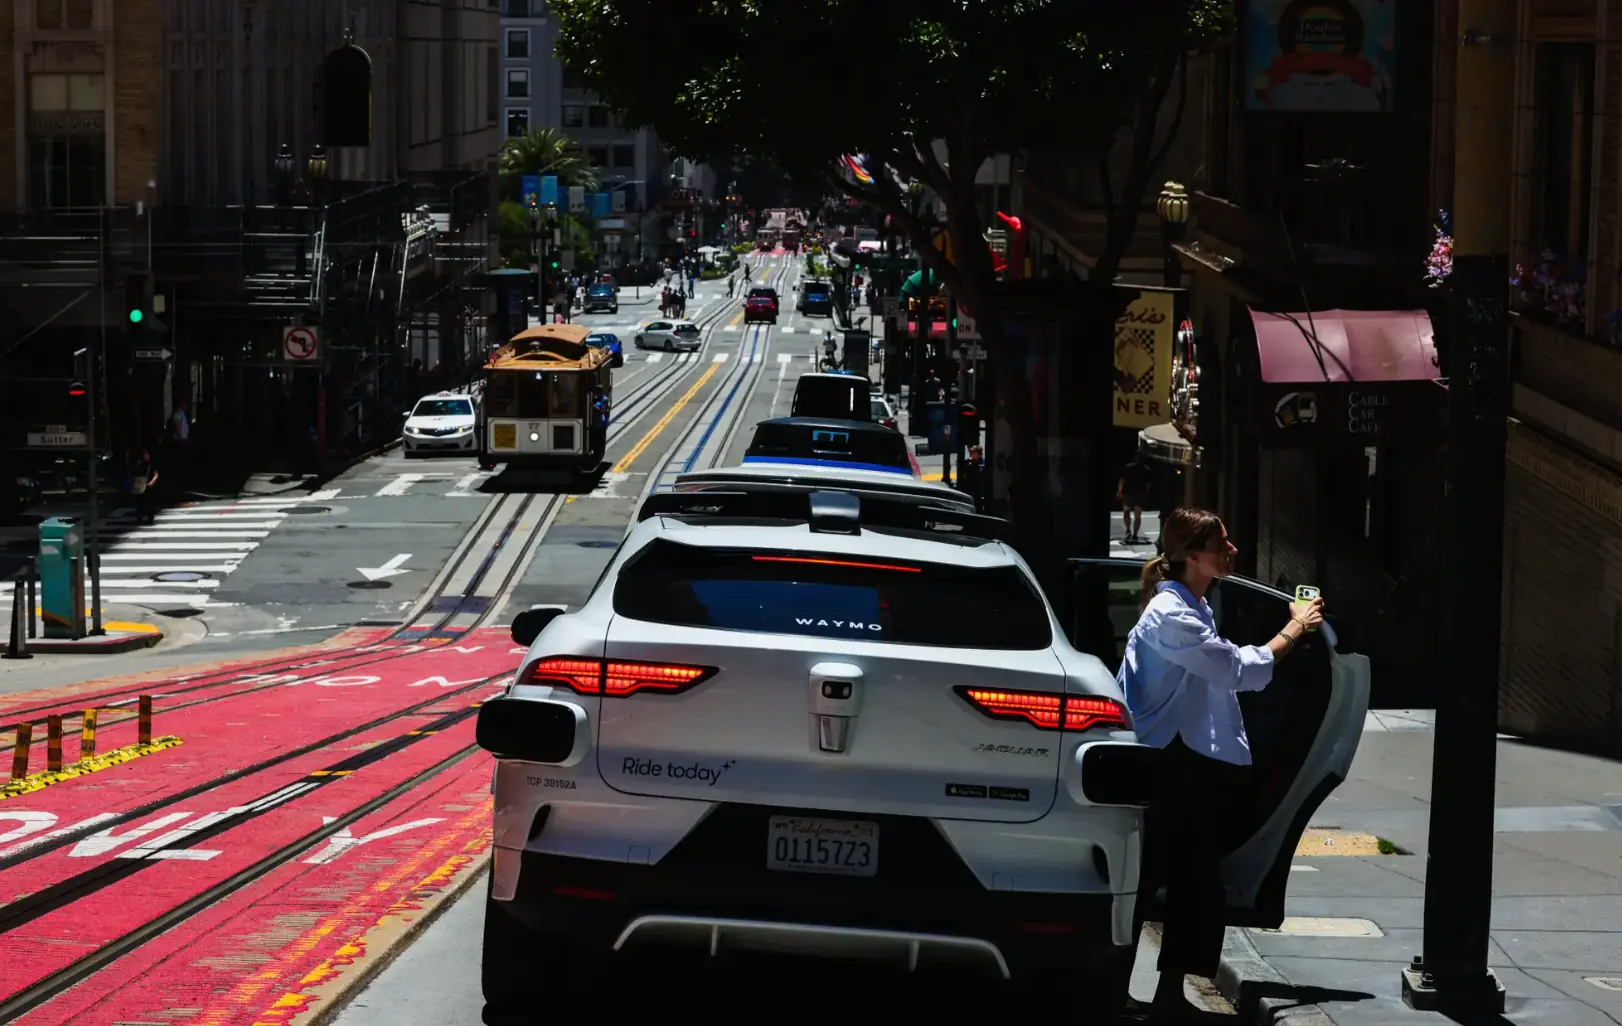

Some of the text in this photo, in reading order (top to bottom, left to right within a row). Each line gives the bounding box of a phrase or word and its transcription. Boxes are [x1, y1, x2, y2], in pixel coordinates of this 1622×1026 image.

[1348, 391, 1389, 406] CABLE
[1116, 397, 1161, 417] NER
[1348, 404, 1375, 420] CAR
[40, 434, 74, 443] Sutter
[795, 618, 882, 631] WAYMO
[971, 743, 1049, 757] JAGUAR
[622, 757, 722, 786] Ride today
[526, 776, 577, 790] TCP 38152A
[792, 821, 858, 838] California
[775, 837, 870, 867] 01157Z3
